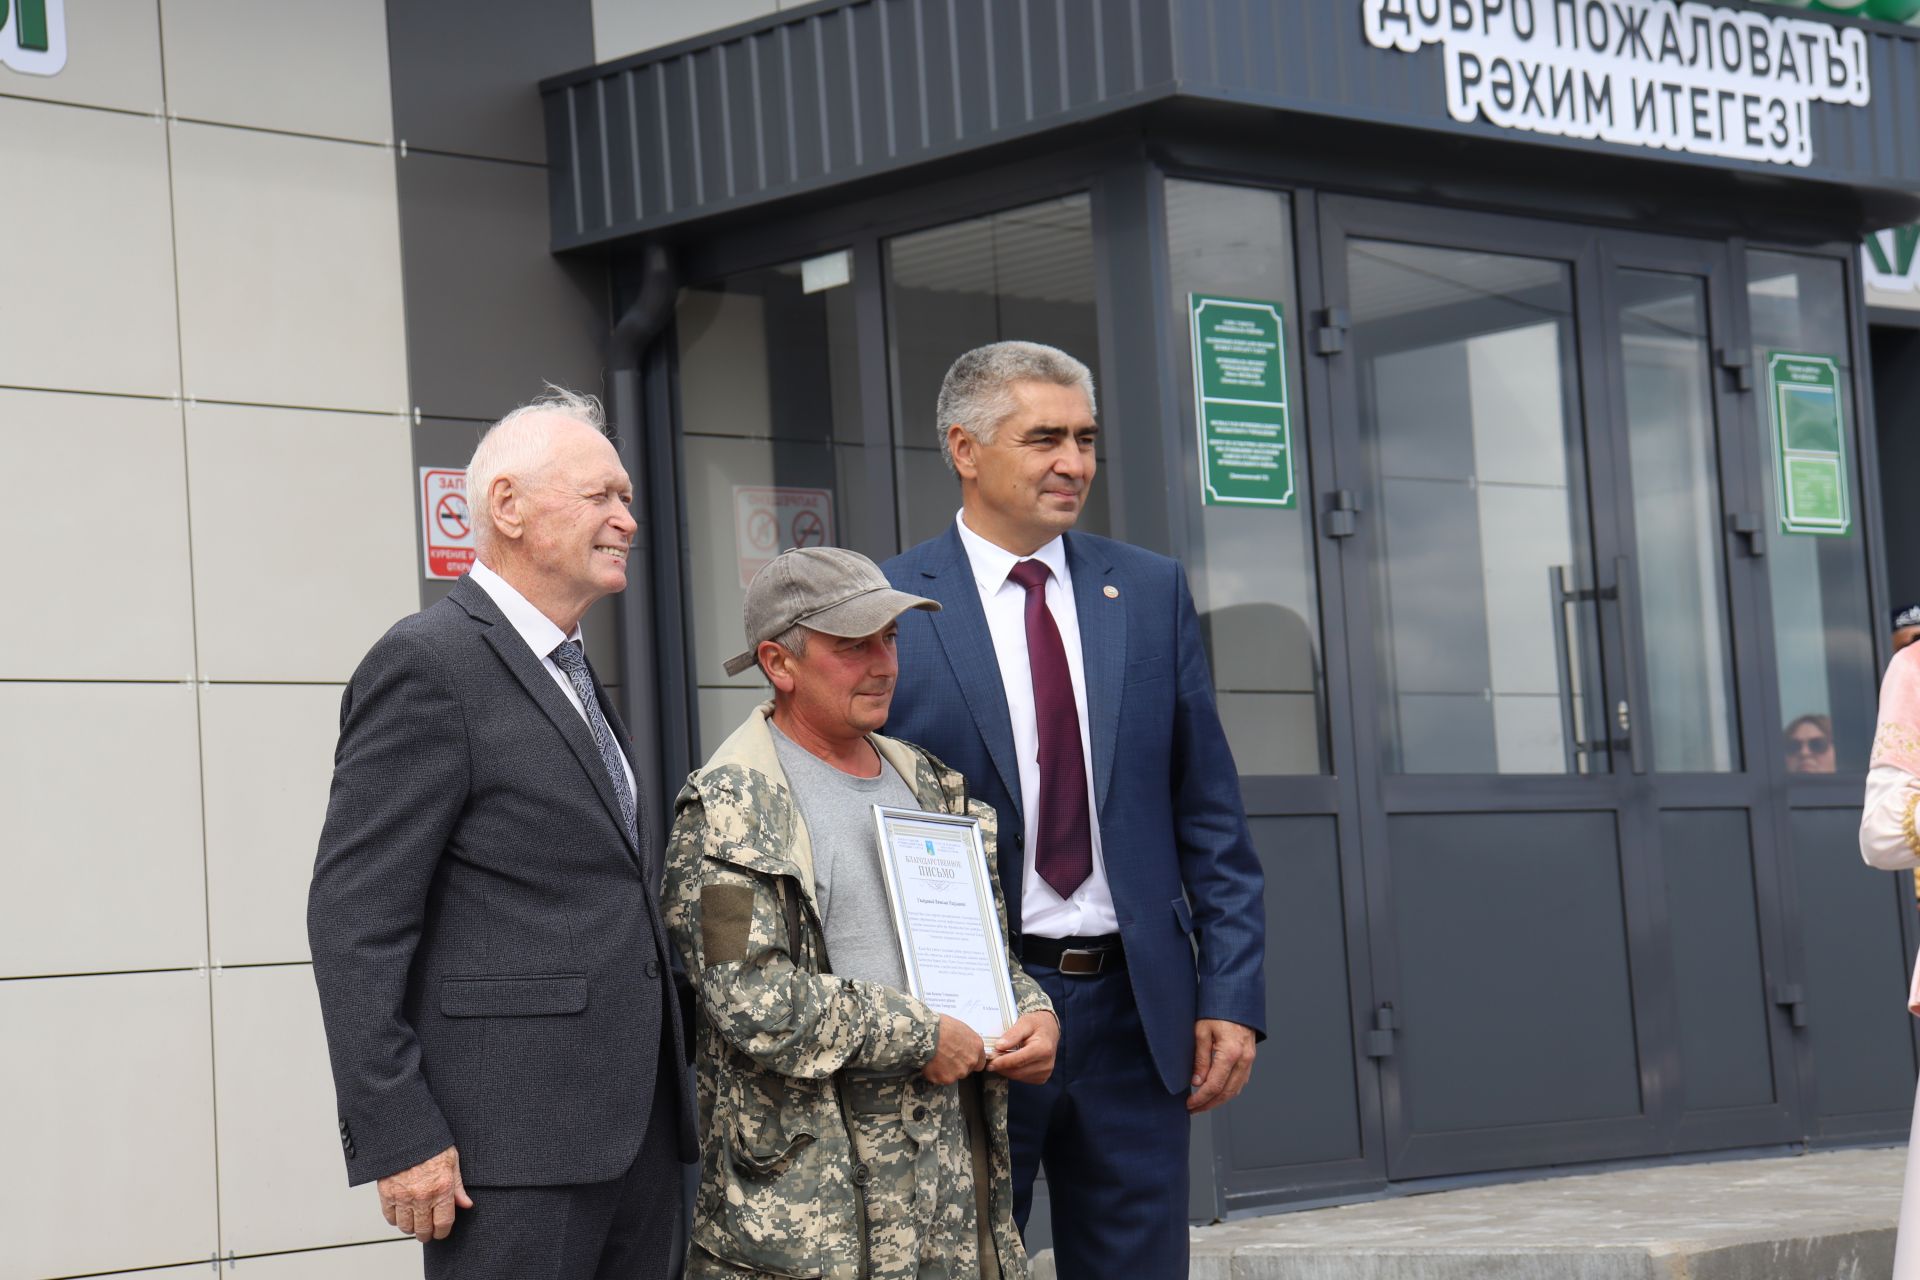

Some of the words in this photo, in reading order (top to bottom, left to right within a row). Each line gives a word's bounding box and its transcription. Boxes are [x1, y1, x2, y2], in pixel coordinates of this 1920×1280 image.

[1379, 0, 1535, 41] ДОБРО
[1553, 0, 1862, 92] ПОЖАЛОВАТЬ!
[1457, 51, 1614, 127] РӘХИМ
[1631, 76, 1805, 152] ИТЕГЕЗ!
[439, 477, 467, 490] ЗАП
[918, 865, 955, 879] ПИСЬМО
